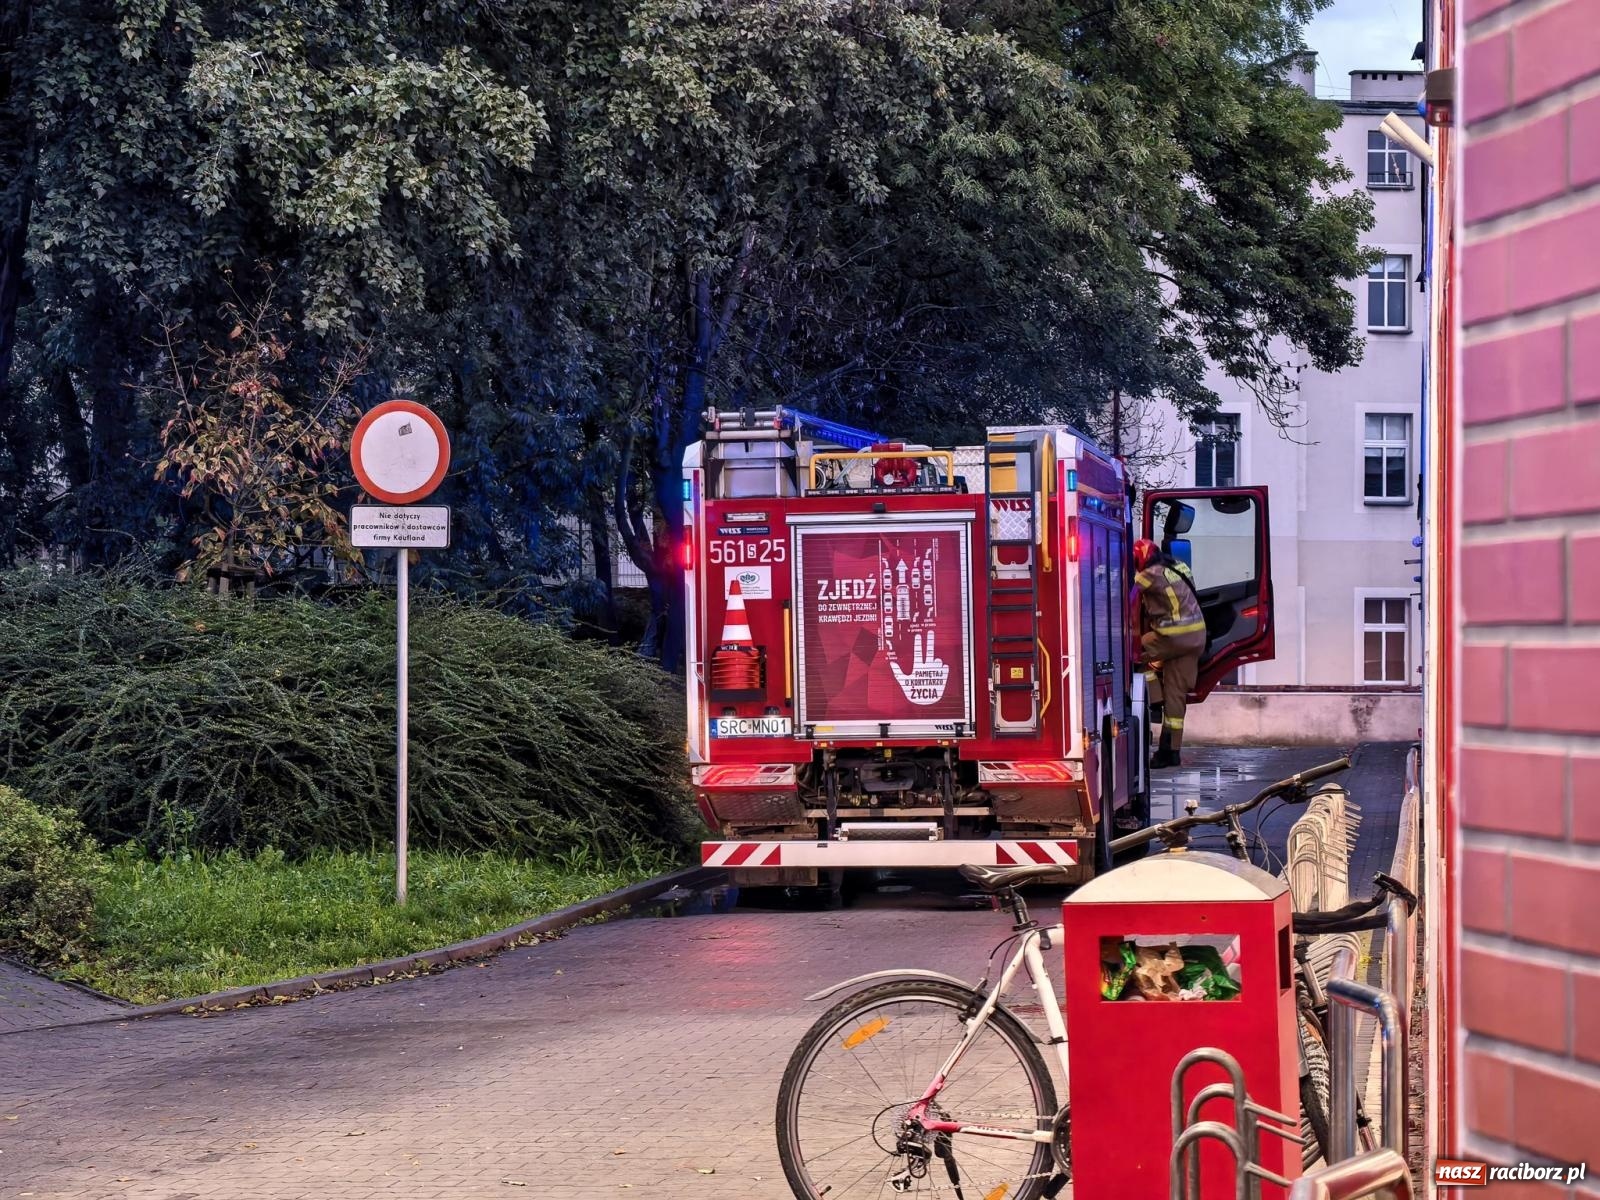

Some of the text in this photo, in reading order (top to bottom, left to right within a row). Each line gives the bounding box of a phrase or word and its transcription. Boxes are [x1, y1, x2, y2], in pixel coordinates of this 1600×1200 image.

[394, 512, 421, 521] dotyczy
[407, 523, 447, 531] dostawców
[373, 534, 425, 542] firmy Kaufland
[709, 540, 745, 563] 561
[759, 539, 786, 562] 25
[817, 573, 877, 600] ZJEDŹ
[818, 602, 877, 613] DO ZEWNĘTRZNEJ
[818, 613, 877, 624] KRAWĘDZI JEZDNI
[915, 670, 944, 678] PAMIĘTAJ
[910, 679, 944, 687] KORYTARZU
[910, 686, 938, 700] ŻYCIA
[720, 719, 747, 734] SRC
